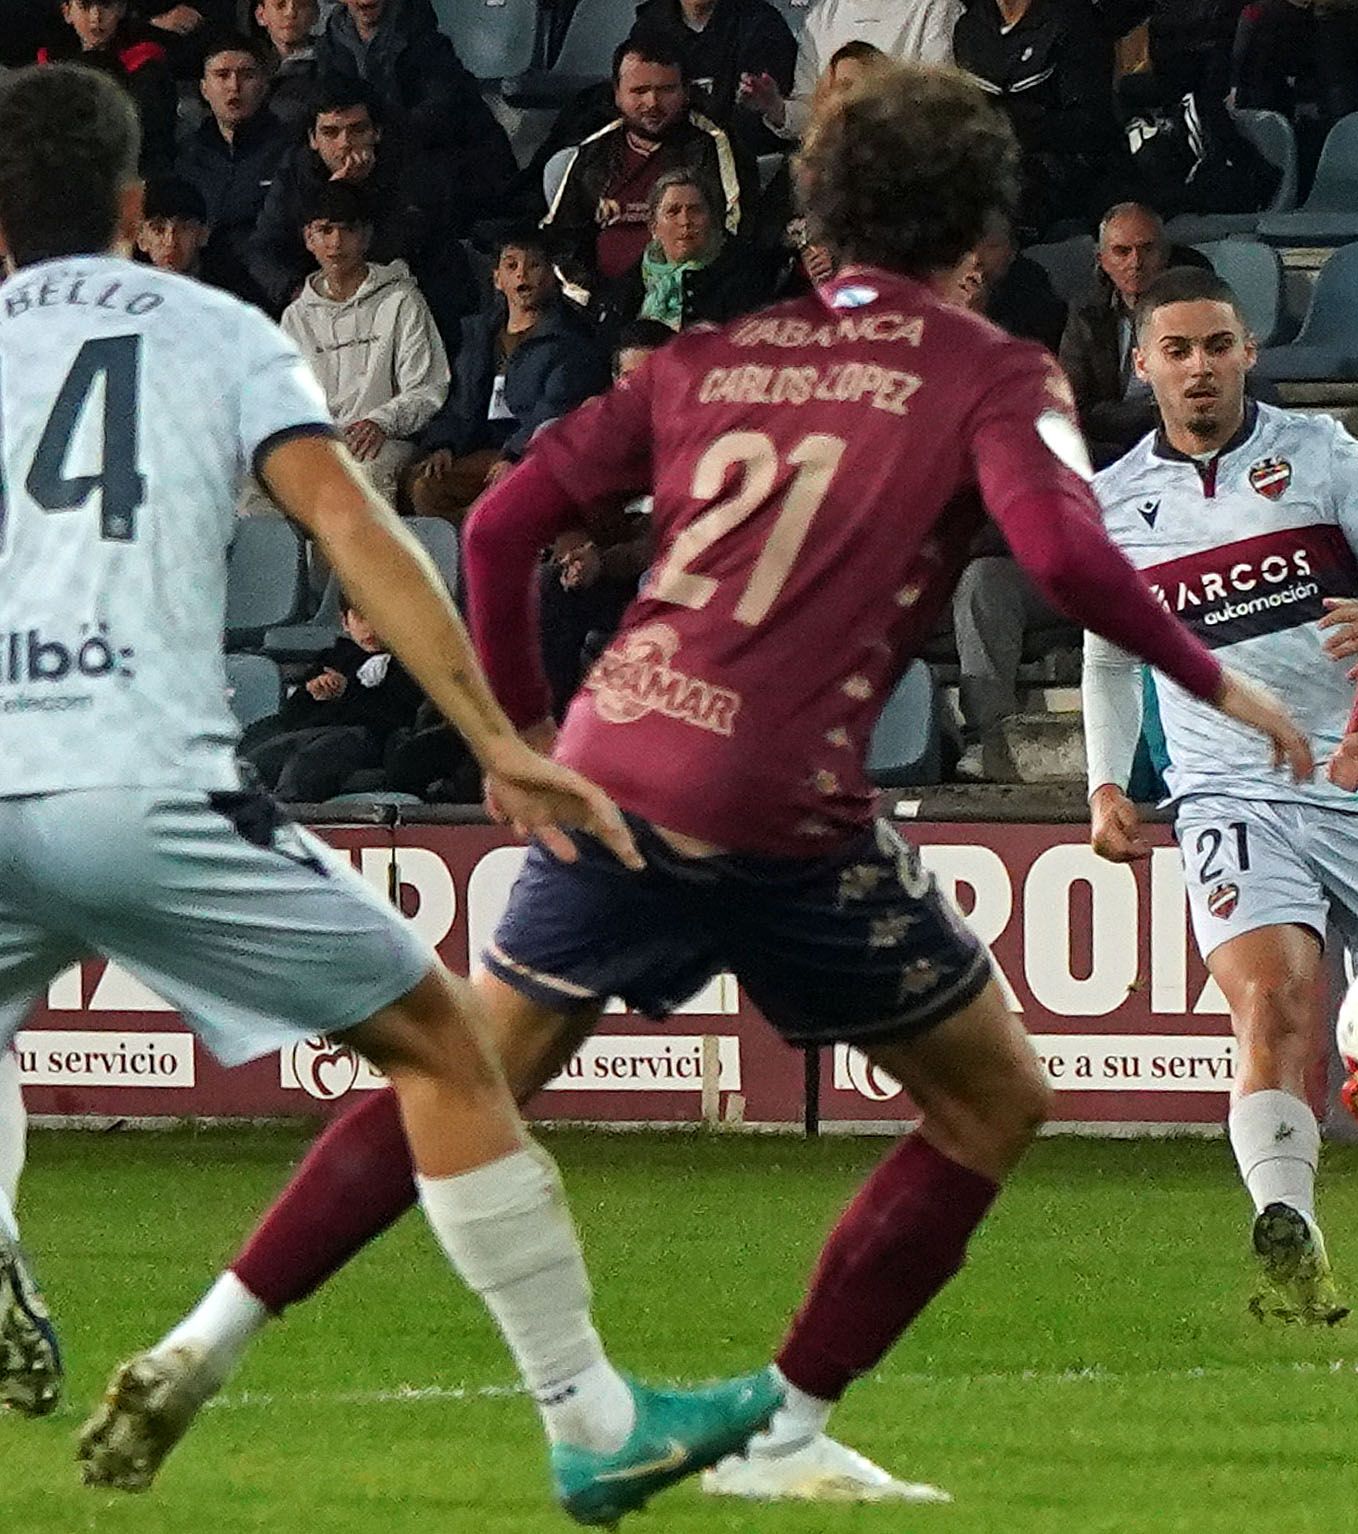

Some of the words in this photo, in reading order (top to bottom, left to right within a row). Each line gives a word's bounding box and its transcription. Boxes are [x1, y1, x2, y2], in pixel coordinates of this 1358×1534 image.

[643, 431, 847, 627] 21
[1196, 822, 1251, 884] 21
[48, 1042, 178, 1075] servicio
[1074, 1054, 1093, 1078] a
[1103, 1055, 1141, 1078] su
